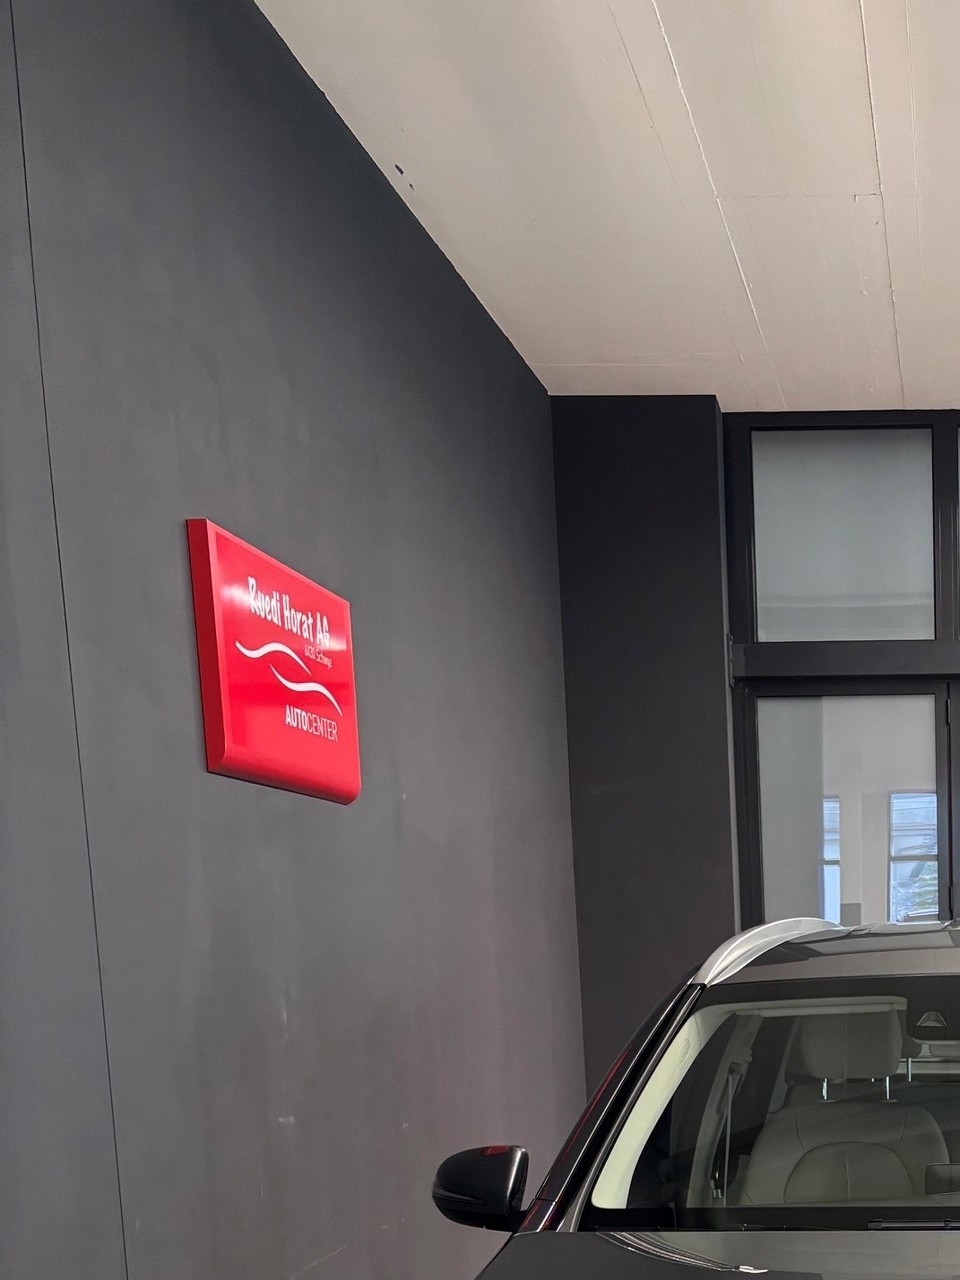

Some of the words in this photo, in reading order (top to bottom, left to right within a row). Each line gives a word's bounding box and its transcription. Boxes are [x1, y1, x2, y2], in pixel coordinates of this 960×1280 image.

[248, 576, 281, 627] Ruedi
[283, 594, 313, 642] Horat
[316, 612, 330, 649] AG
[285, 704, 338, 742] AUTOCENTER
